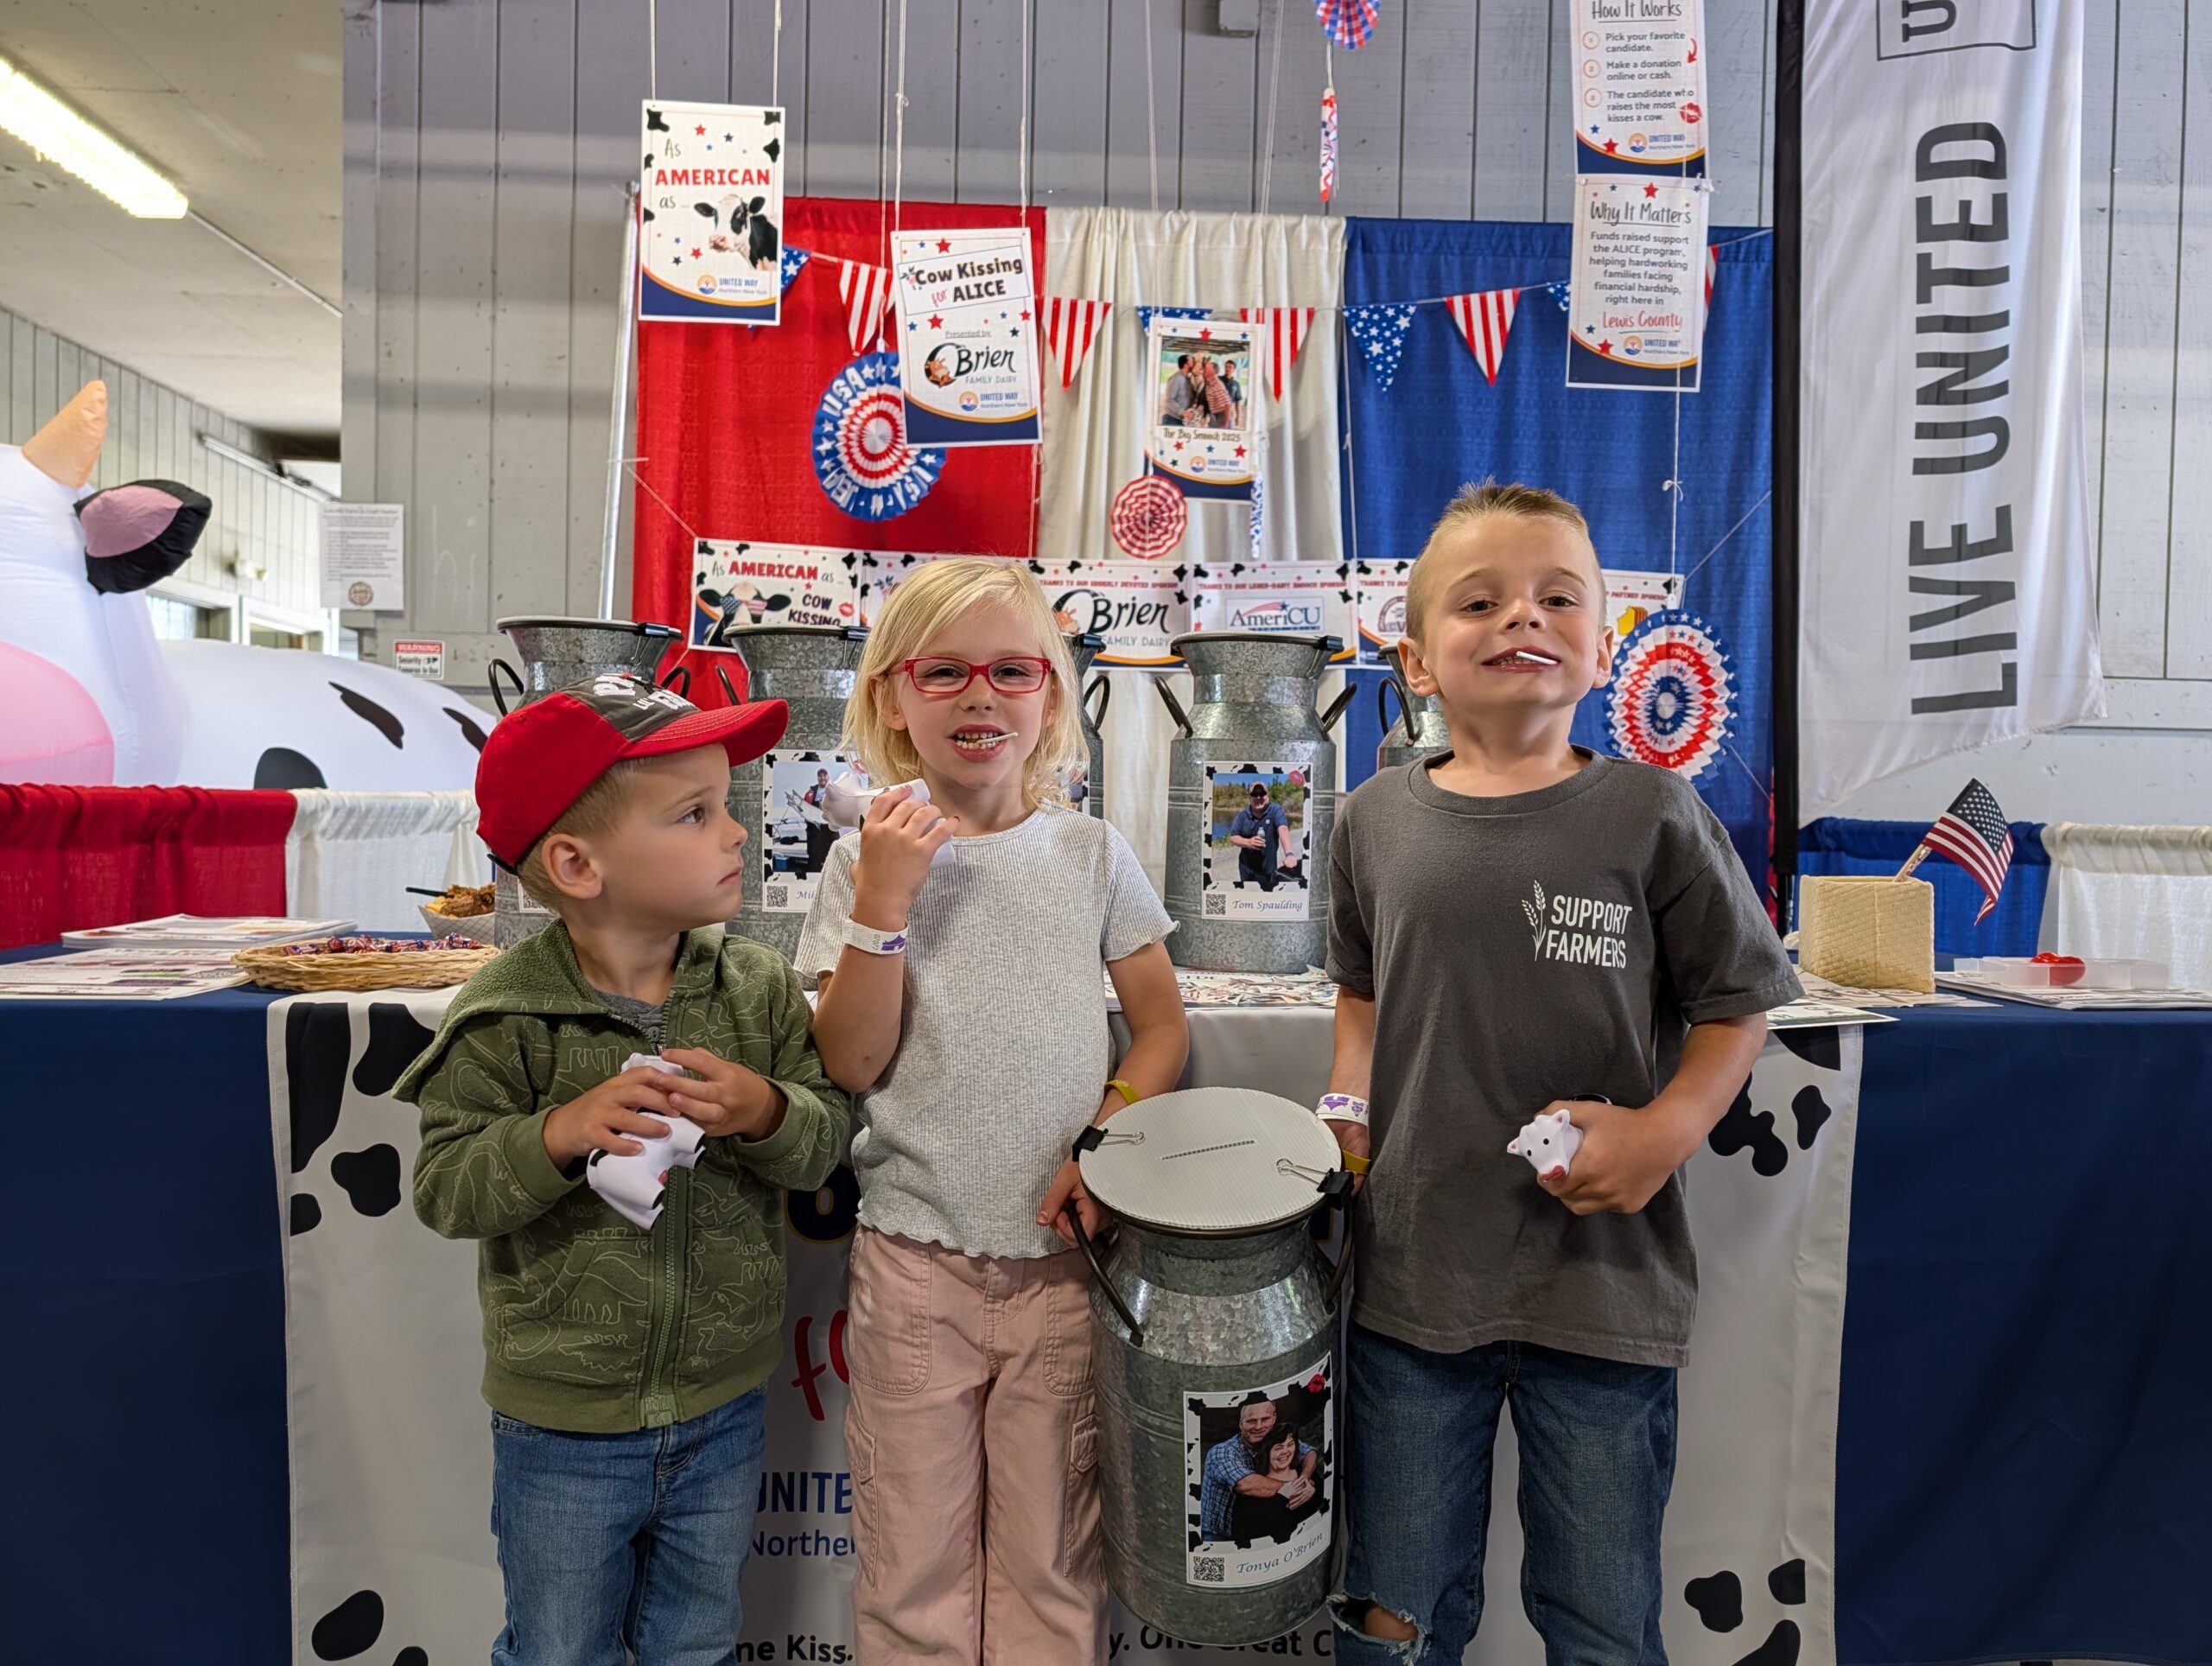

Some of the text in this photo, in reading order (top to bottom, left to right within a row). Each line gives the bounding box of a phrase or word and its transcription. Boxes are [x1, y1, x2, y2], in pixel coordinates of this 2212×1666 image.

[1592, 0, 1682, 19] How It Works
[1627, 35, 1647, 43] your
[1607, 91, 1624, 99] The
[1627, 90, 1672, 99] candidate
[1649, 134, 1671, 143] UNITED
[664, 138, 682, 159] As
[655, 169, 770, 187] AMERICAN
[660, 195, 676, 209] as
[1590, 200, 1692, 226] Why It Matters
[1591, 232, 1688, 245] Funds raised support
[1593, 244, 1610, 253] the
[1612, 245, 1641, 254] ALICE
[914, 258, 1023, 285] Cow Kissing
[1589, 257, 1688, 270] helping hardworking
[719, 277, 742, 286] UNITED
[1604, 270, 1673, 282] families facing
[931, 280, 1006, 308] for ALICE
[1594, 282, 1681, 295] financial hardship,
[1605, 295, 1664, 305] right here in
[1603, 310, 1682, 332] Lewis County
[965, 375, 1017, 385] FAMILY DAIRY
[1909, 121, 2018, 715] LIVE UNITED
[1164, 428, 1175, 439] The
[712, 561, 725, 576] As
[728, 561, 818, 581] AMERICAN
[821, 572, 835, 582] as
[802, 593, 832, 610] COW
[787, 608, 842, 626] KISSING
[1230, 606, 1321, 626] AmeriCU
[1101, 635, 1171, 648] FAMILY DAIRY
[1232, 900, 1303, 911] Tom Spaulding
[1551, 894, 1632, 935] SUPPORT
[1545, 929, 1626, 969] FARMERS
[1236, 1531, 1324, 1574] Tonya O'Brien
[787, 1634, 854, 1665] Kiss.
